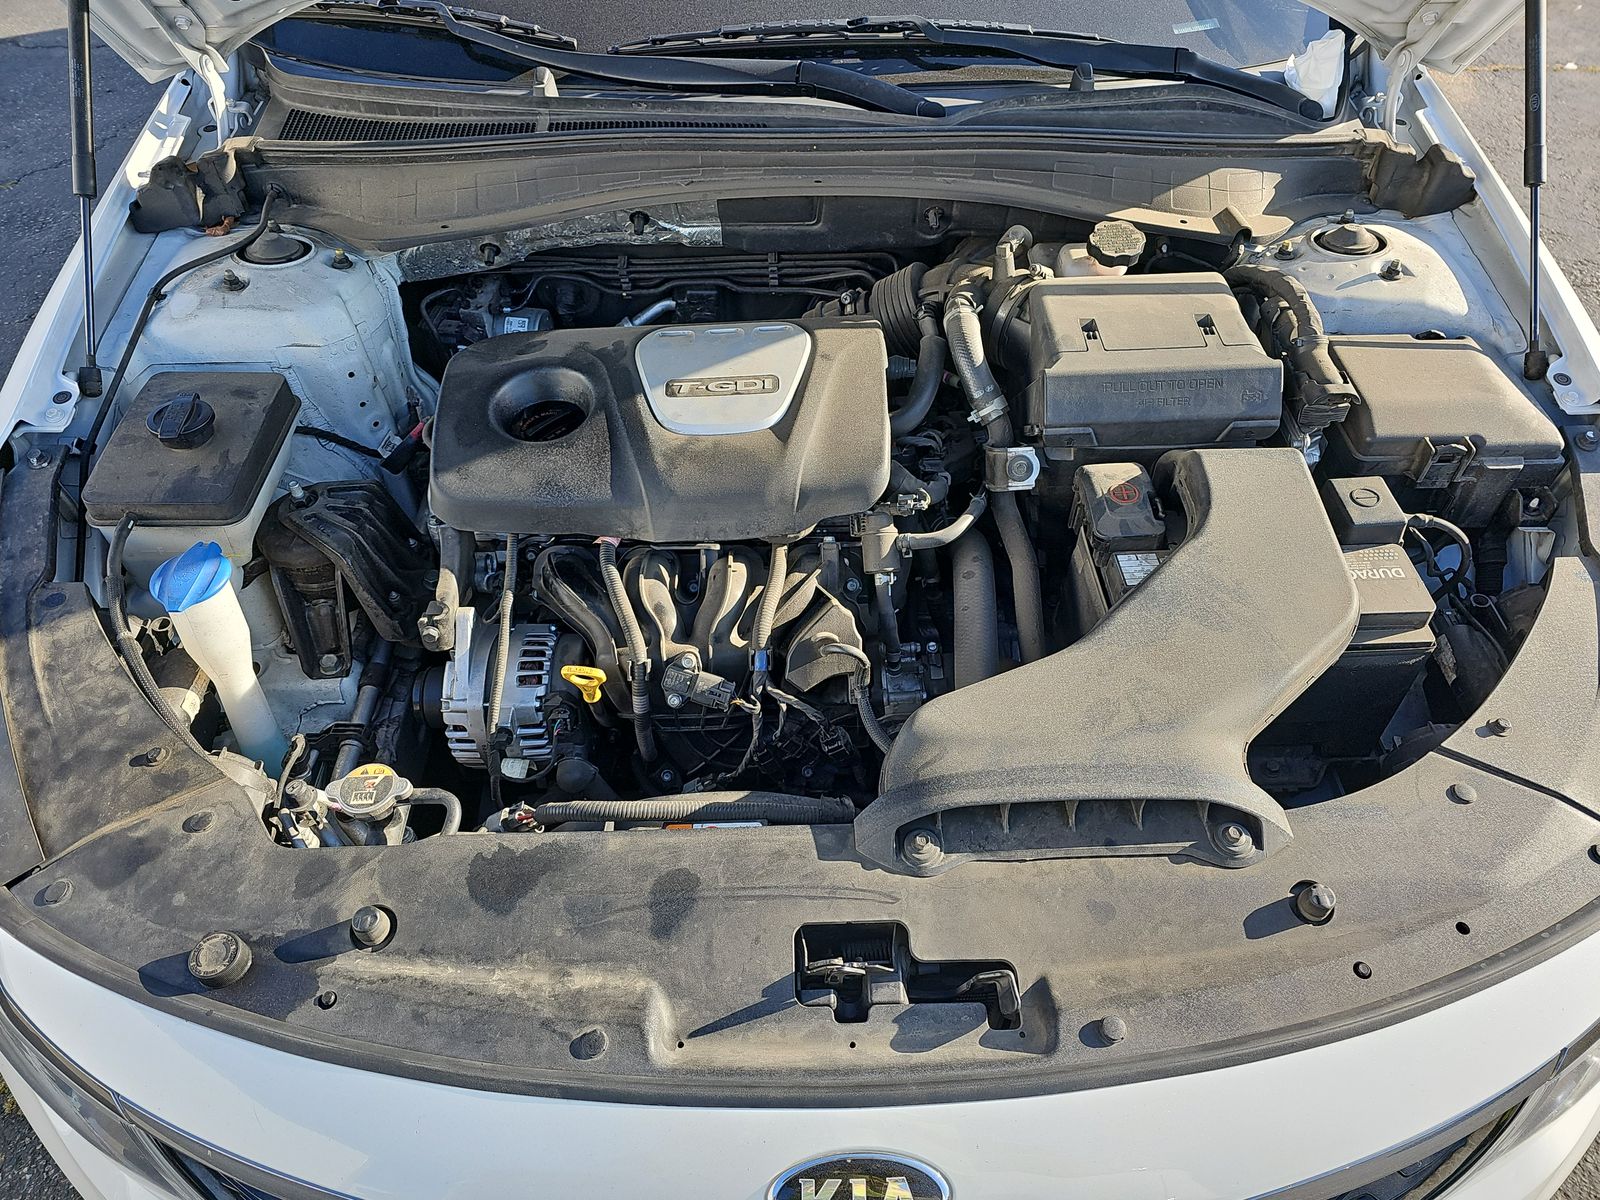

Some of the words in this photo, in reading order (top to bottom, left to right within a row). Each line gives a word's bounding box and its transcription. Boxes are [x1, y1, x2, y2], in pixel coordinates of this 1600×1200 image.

[672, 379, 773, 394] T-GDI
[1103, 381, 1136, 393] PULL
[1138, 380, 1165, 392] OUT
[1168, 380, 1186, 391] TO
[1189, 378, 1223, 390] OPEN
[1157, 397, 1191, 407] FILTER
[799, 1176, 914, 1200] KIA
